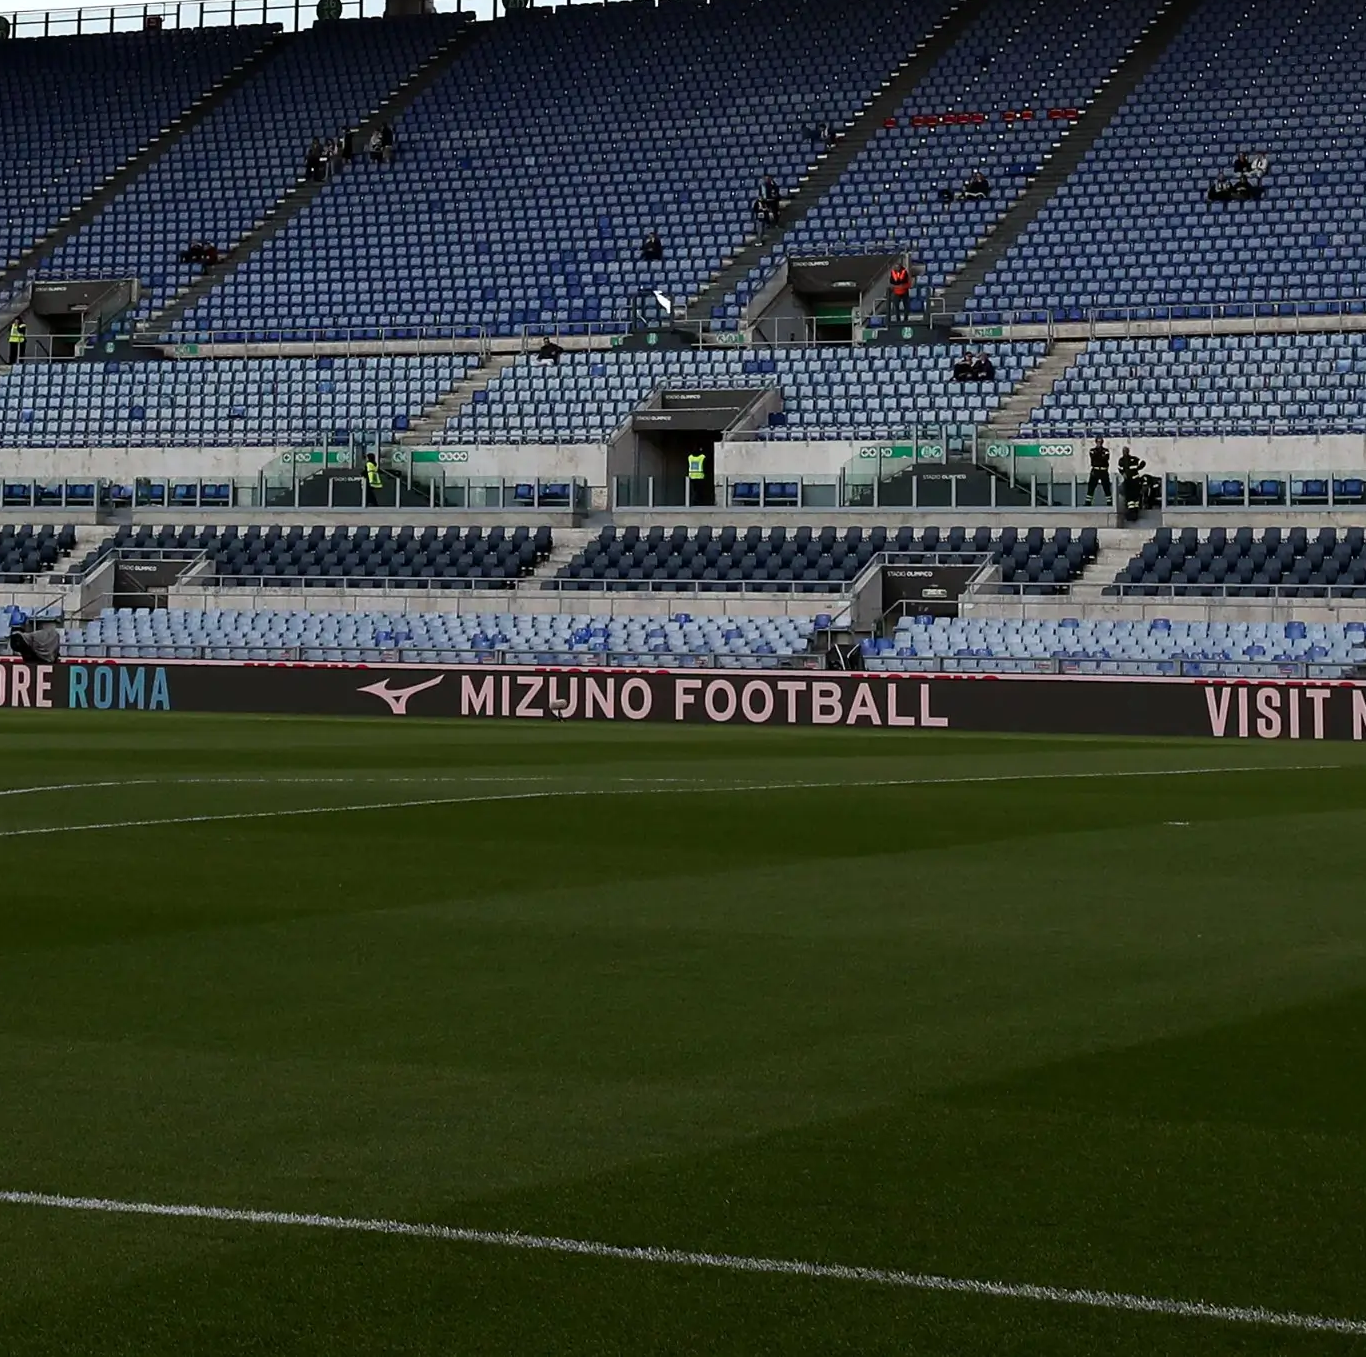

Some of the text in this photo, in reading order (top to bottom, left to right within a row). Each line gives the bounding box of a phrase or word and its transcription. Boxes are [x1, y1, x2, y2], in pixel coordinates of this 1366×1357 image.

[69, 665, 171, 710] ROMA
[462, 675, 949, 727] MIZUNO FOOTBALL
[1205, 686, 1331, 739] VISIT
